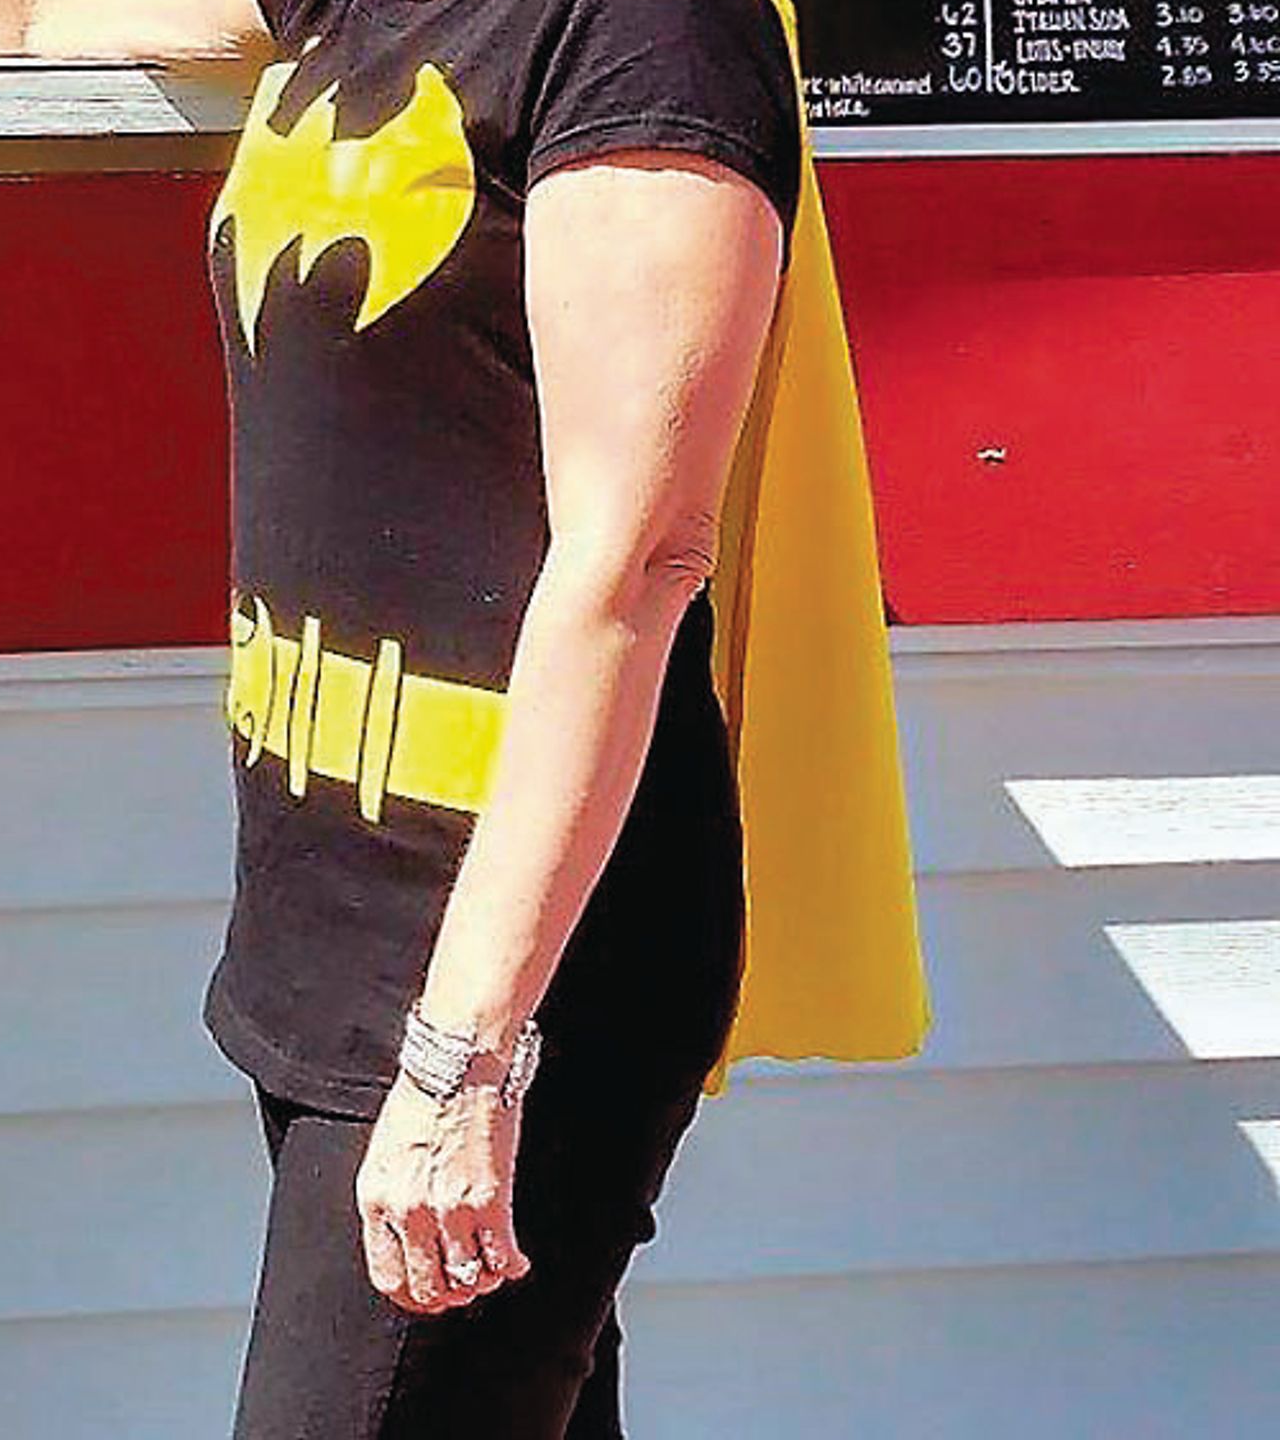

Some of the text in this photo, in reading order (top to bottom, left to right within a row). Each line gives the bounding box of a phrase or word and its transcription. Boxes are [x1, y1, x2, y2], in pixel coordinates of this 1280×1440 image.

[1011, 8, 1087, 33] ITALIAN
[1088, 6, 1131, 32] SODA
[1017, 68, 1082, 95] CIDER
